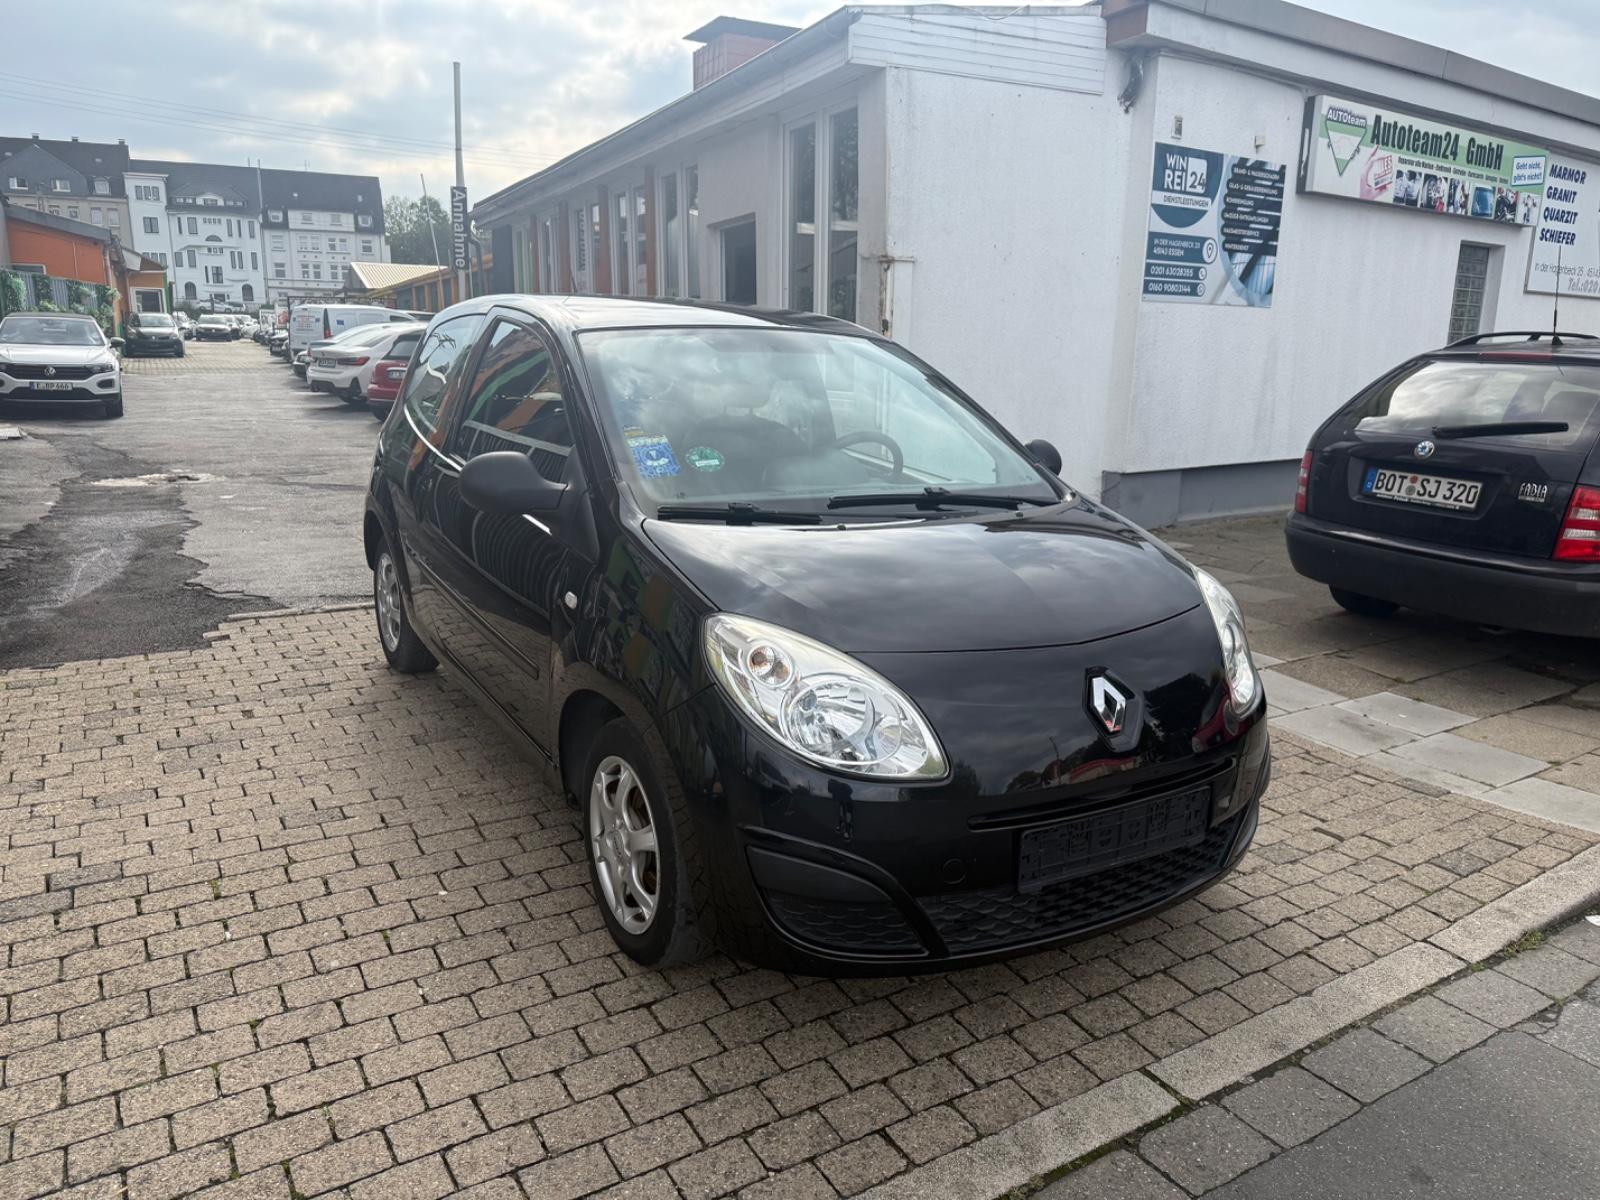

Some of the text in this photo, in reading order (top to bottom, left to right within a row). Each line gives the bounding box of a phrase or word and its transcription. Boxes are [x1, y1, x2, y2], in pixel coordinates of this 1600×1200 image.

[1327, 108, 1367, 128] AUTOteam
[1370, 114, 1459, 161] Autoteam24
[1466, 137, 1504, 171] GmbH
[1166, 153, 1188, 171] WIN
[1515, 161, 1528, 170] Geht
[1163, 169, 1187, 191] REI
[1189, 171, 1207, 191] 24
[1549, 164, 1587, 184] MARMOR
[1546, 185, 1578, 204] GRANIT
[1543, 206, 1579, 225] QUARZIT
[453, 189, 468, 268] Annahme
[1539, 228, 1577, 246] SCHIEFER
[1168, 248, 1184, 256] ESSEN
[1150, 265, 1165, 275] 0201
[1148, 282, 1163, 292] 0160
[1374, 472, 1408, 494] BOT
[1416, 478, 1442, 499] SJ
[1442, 481, 1479, 505] 320
[1519, 482, 1548, 499] FABIA
